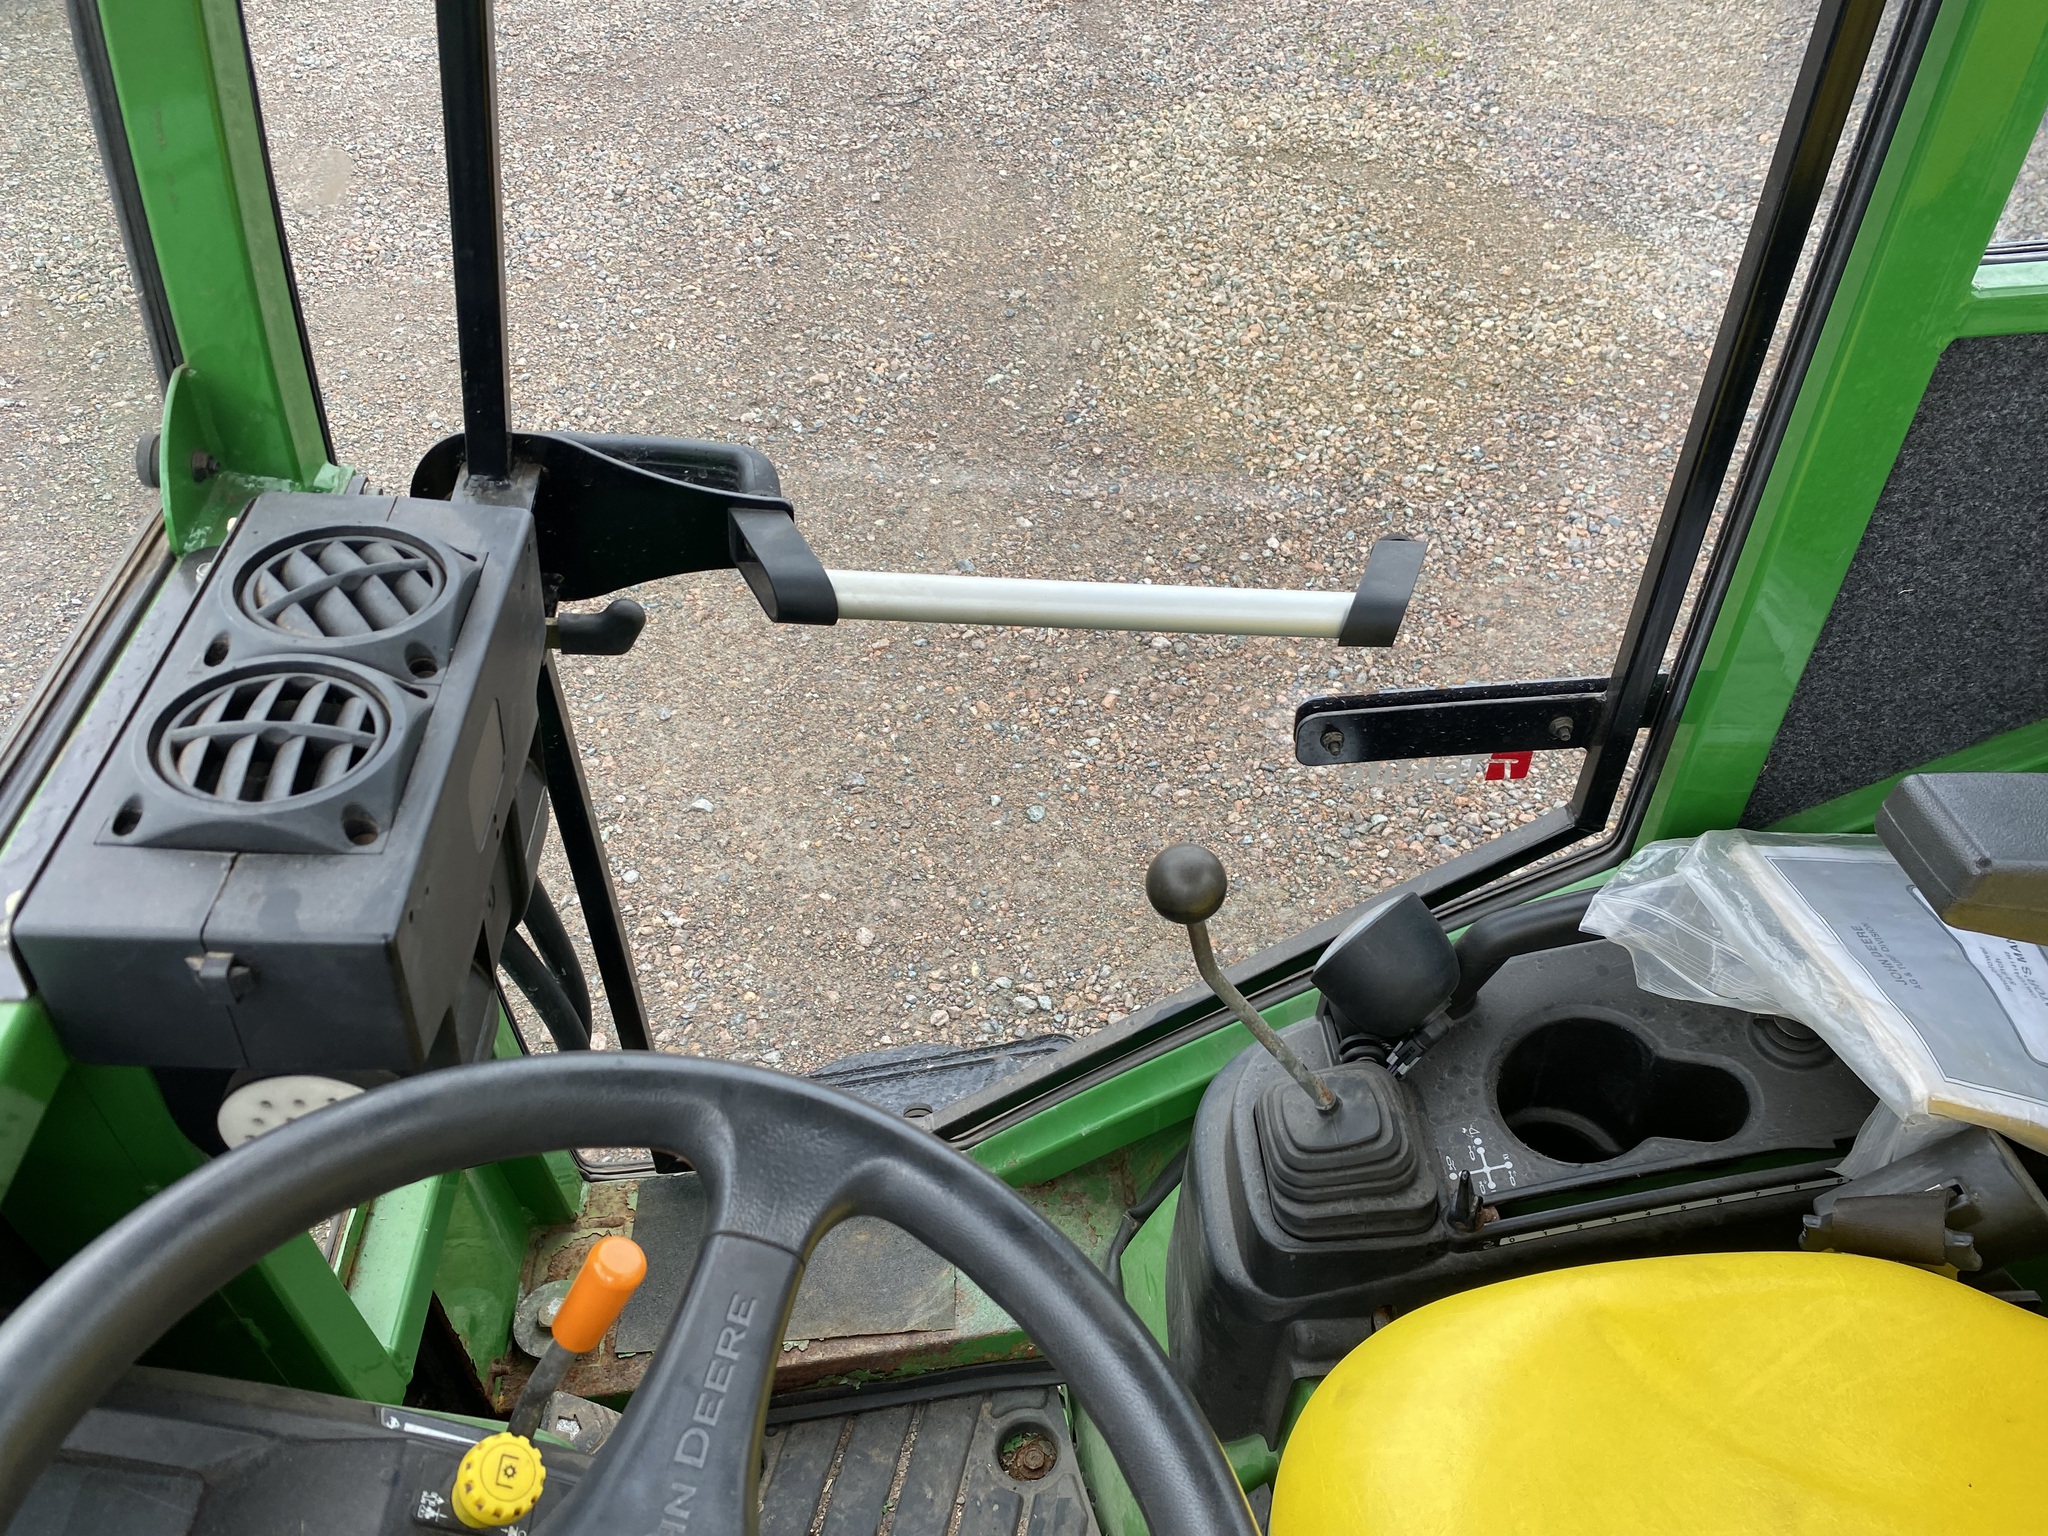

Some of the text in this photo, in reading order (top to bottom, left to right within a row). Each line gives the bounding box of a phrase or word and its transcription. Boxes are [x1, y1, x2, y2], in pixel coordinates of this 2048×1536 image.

[1850, 925, 1908, 986] JOHN DEERE
[1861, 922, 1890, 953] DIVISION
[1885, 953, 1906, 970] TURF
[1908, 979, 1924, 991] AG
[2021, 966, 2048, 1007] TOR'S
[674, 1293, 758, 1468] DEERE
